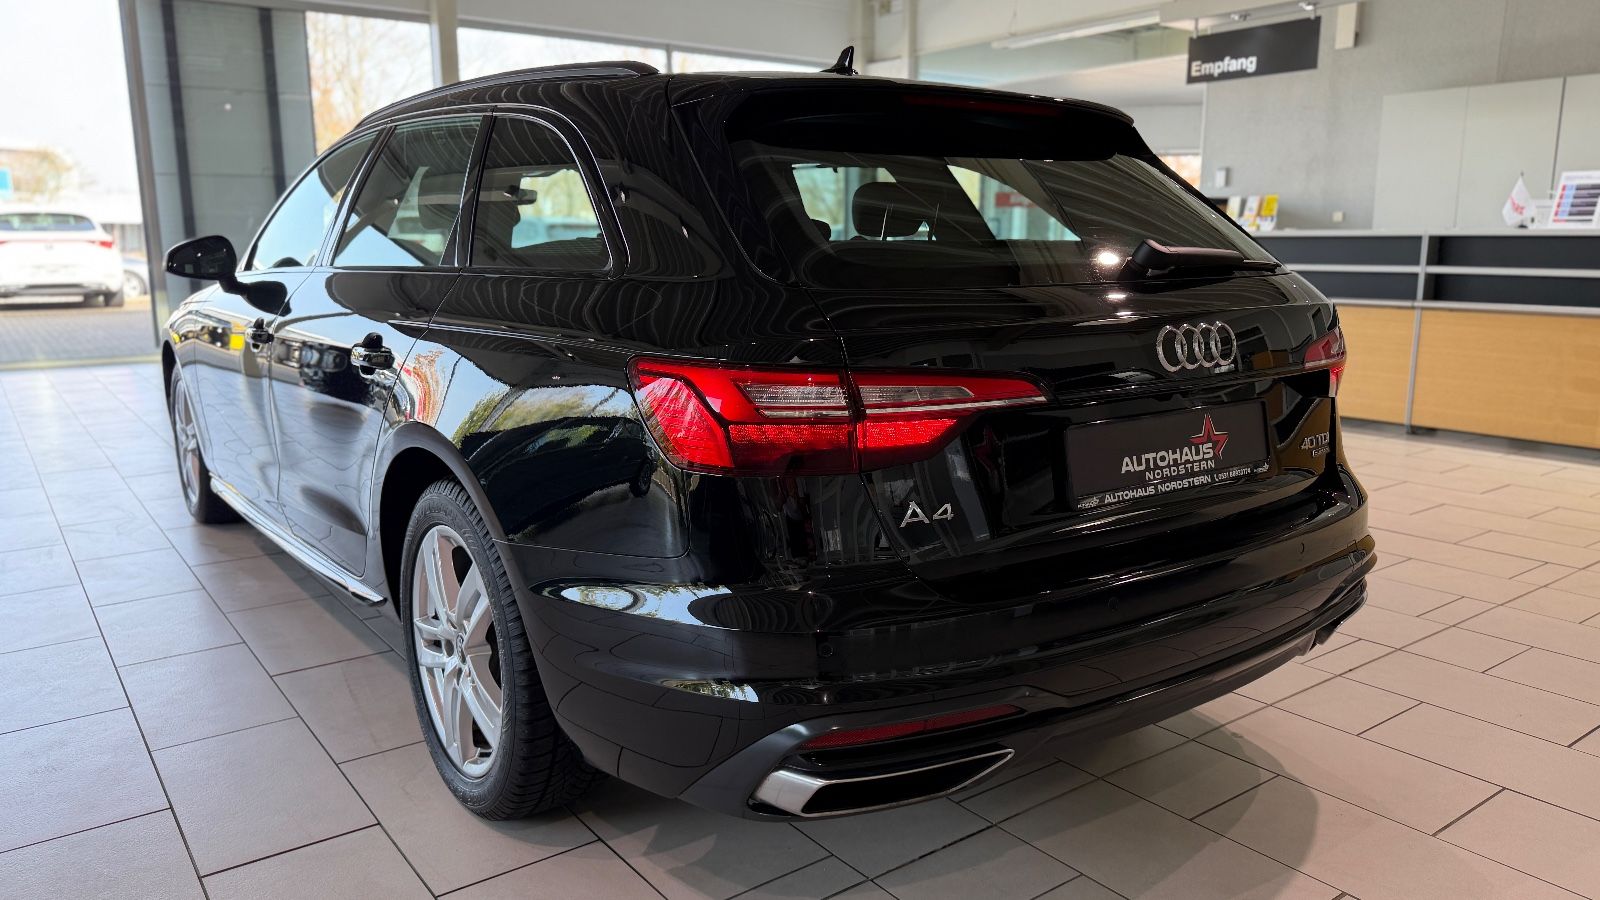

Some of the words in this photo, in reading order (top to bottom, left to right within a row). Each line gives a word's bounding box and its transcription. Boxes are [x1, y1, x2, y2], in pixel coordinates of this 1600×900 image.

[1191, 56, 1257, 77] Empfang
[1301, 437, 1316, 449] 40
[1121, 443, 1214, 473] AUTOHAUS
[1145, 459, 1215, 480] NORDSTERN
[1104, 485, 1155, 504] AUTOHAUS
[1157, 474, 1211, 493] NORDSTERN
[900, 500, 954, 527] A4
